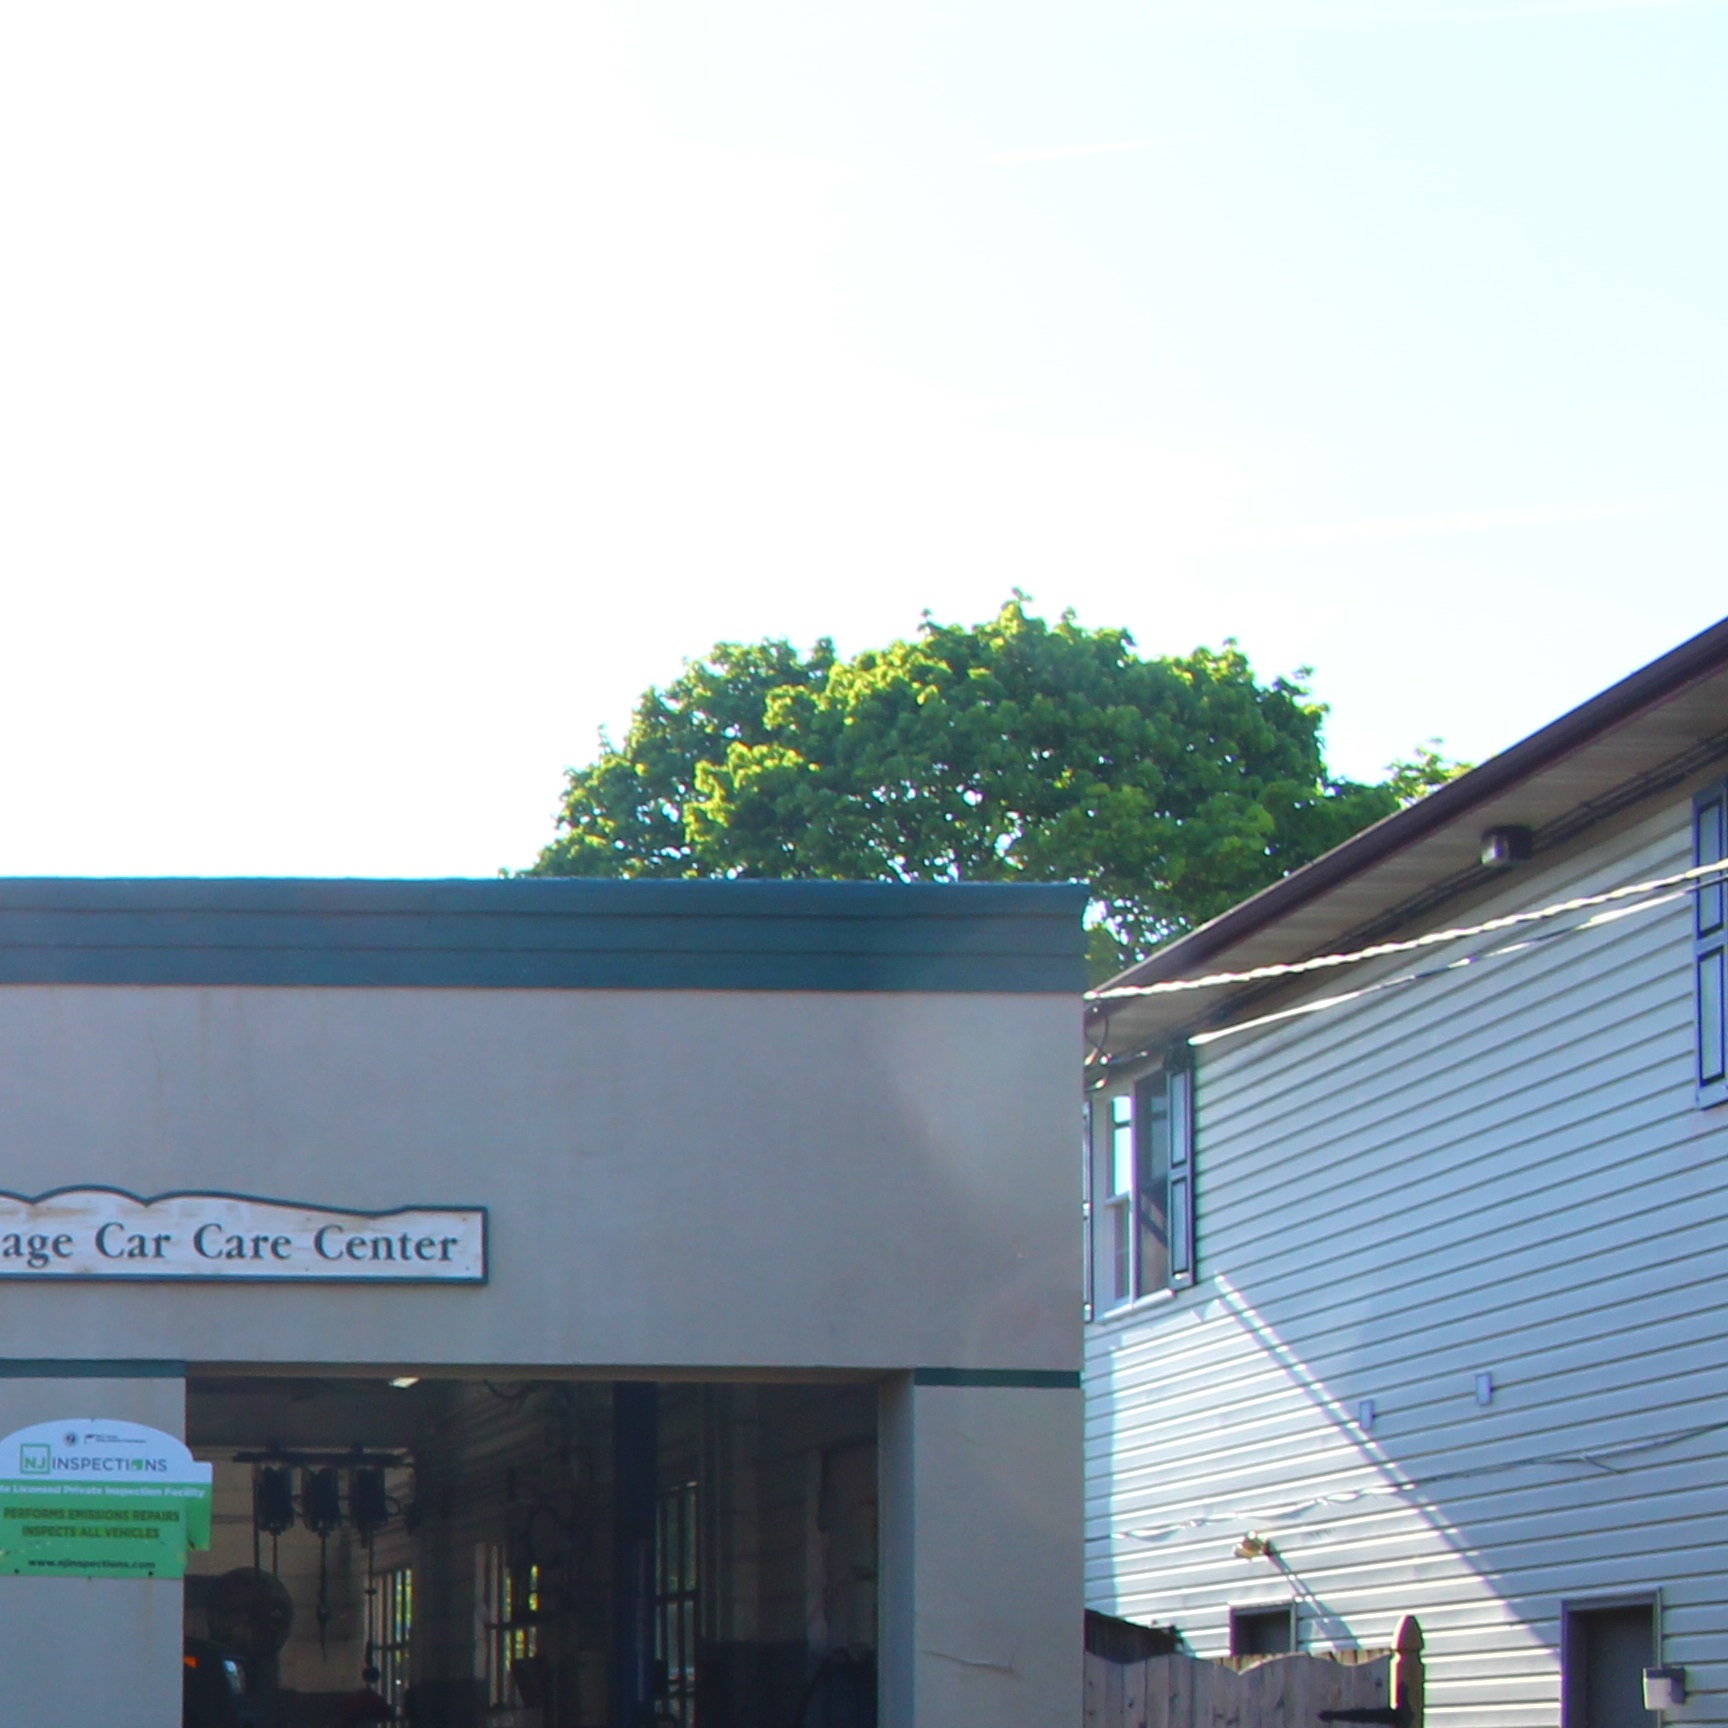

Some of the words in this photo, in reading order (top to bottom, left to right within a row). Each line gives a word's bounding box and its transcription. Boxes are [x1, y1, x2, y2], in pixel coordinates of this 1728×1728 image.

[95, 1222, 171, 1259] Car
[193, 1223, 292, 1260] Care
[313, 1224, 458, 1262] Center
[13, 1484, 61, 1495] Licensed
[63, 1485, 102, 1496] Private
[105, 1486, 162, 1498] Inspection
[164, 1487, 205, 1499] Facility
[4, 1507, 65, 1519] PERFORMS
[69, 1509, 129, 1521] EMISSIONS
[133, 1510, 180, 1522] REPAIRS
[22, 1526, 76, 1537] INSPECTS
[80, 1526, 100, 1537] ALL
[105, 1526, 159, 1538] VEHICLES
